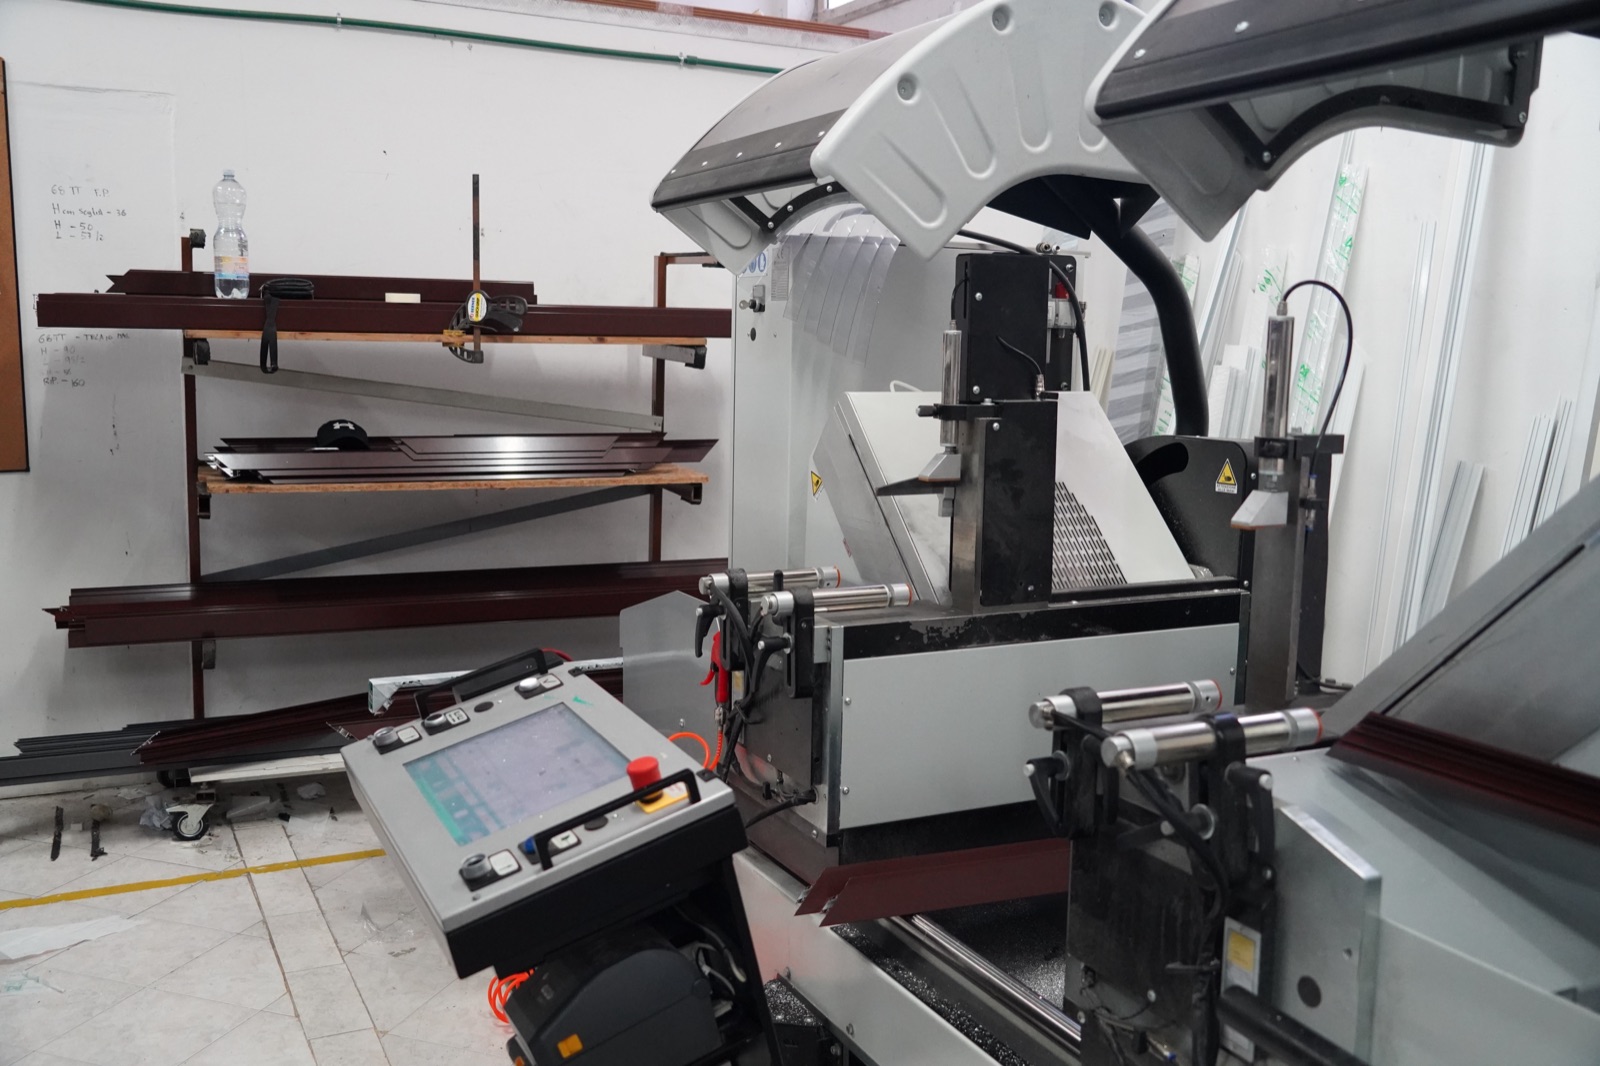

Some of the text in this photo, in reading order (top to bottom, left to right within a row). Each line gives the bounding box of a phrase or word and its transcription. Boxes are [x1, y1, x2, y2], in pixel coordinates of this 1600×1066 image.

[52, 203, 60, 214] H
[54, 220, 61, 229] H
[80, 222, 93, 231] 50
